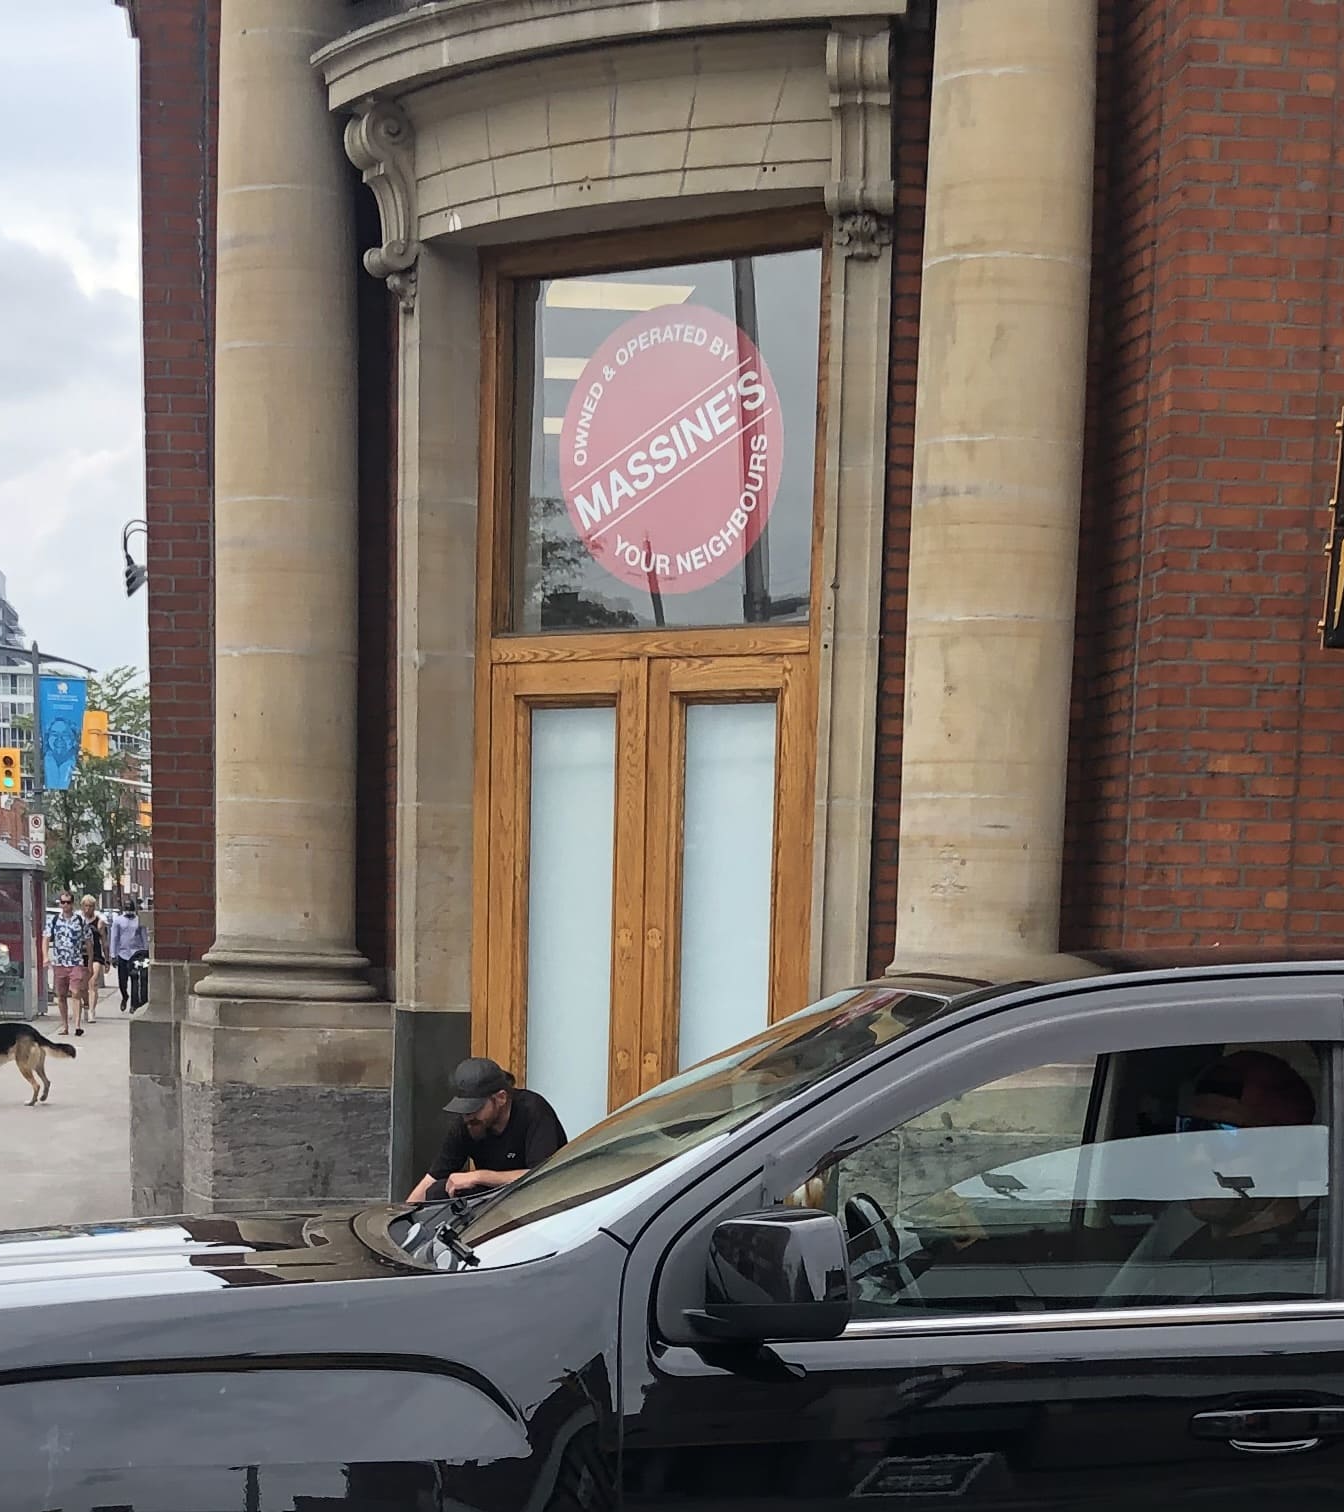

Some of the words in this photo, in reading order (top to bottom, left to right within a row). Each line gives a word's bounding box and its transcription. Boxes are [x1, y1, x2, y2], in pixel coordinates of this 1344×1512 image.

[573, 381, 604, 466] OWNED
[602, 365, 616, 382] &
[615, 323, 707, 366] OPERATED
[709, 336, 734, 363] BY
[573, 370, 766, 531] MASSINE'S
[614, 534, 670, 575] YOUR
[677, 433, 768, 575] NEIGHBOURS
